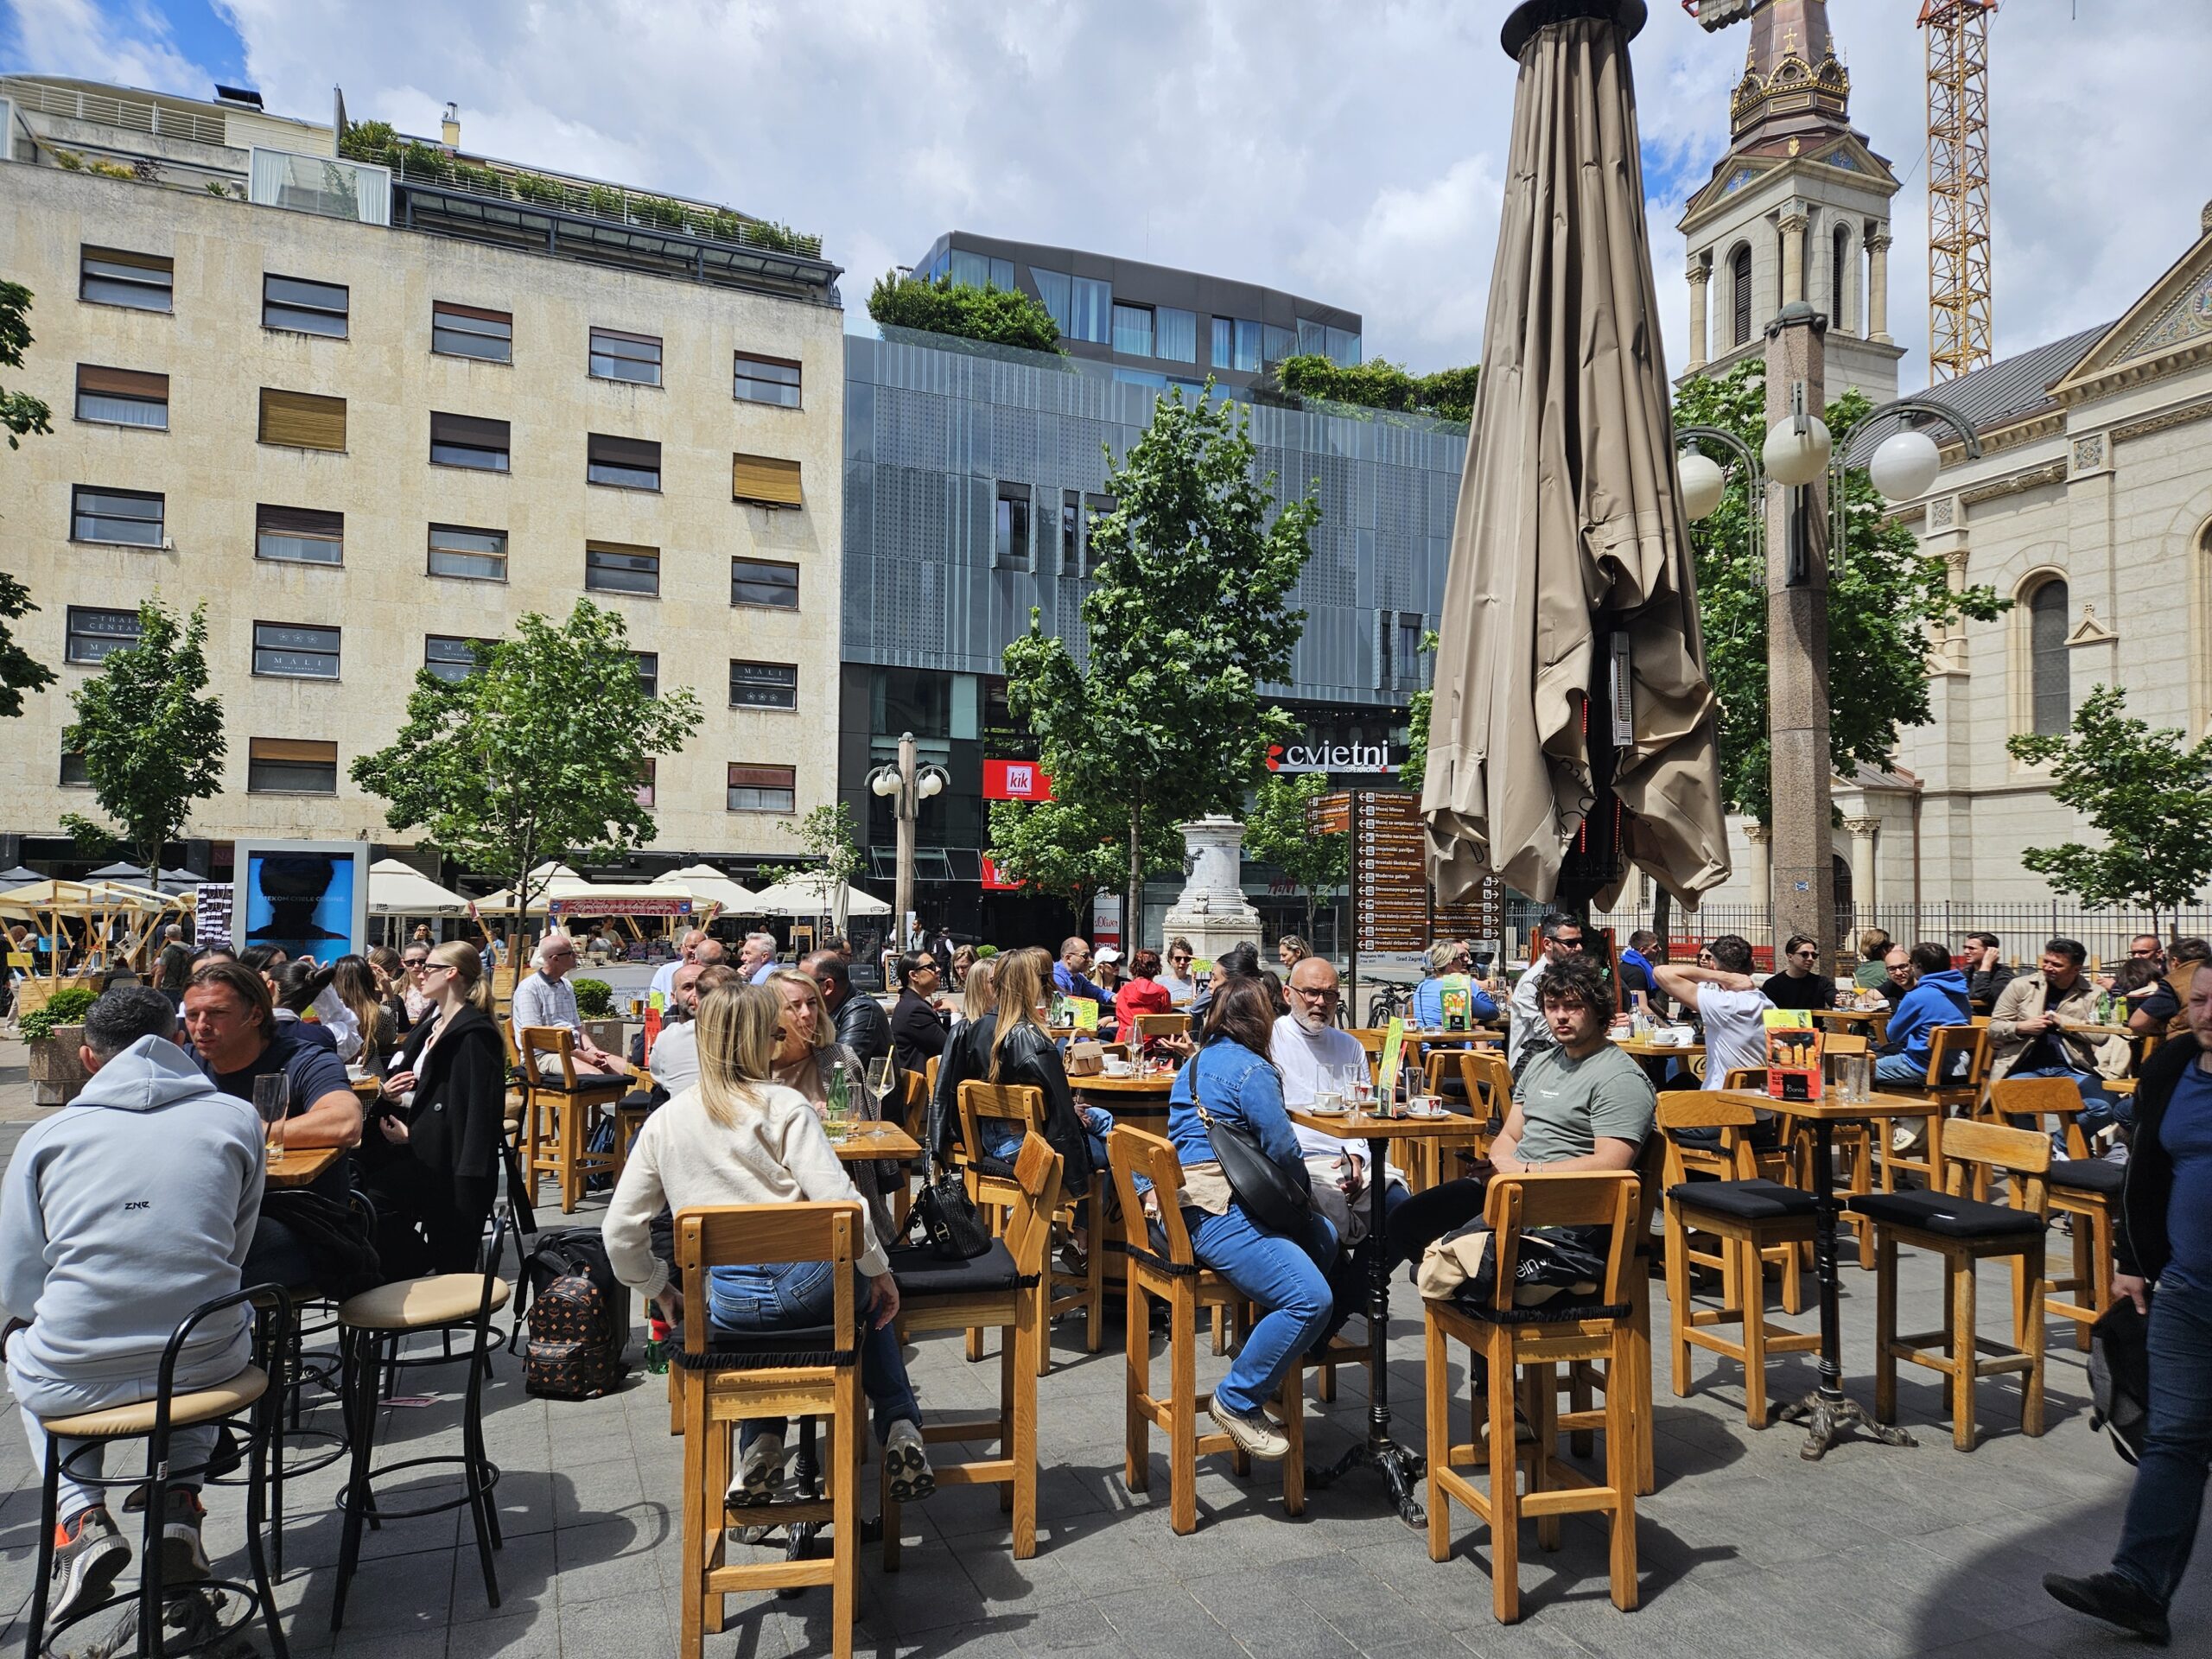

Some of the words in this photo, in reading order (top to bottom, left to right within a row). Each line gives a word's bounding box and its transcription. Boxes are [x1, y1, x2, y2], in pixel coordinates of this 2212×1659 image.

[89, 622, 141, 632] CENTAR
[1287, 740, 1389, 772] cvjetni
[1082, 1002, 1092, 1028] MENU
[1786, 1084, 1805, 1092] Bonita
